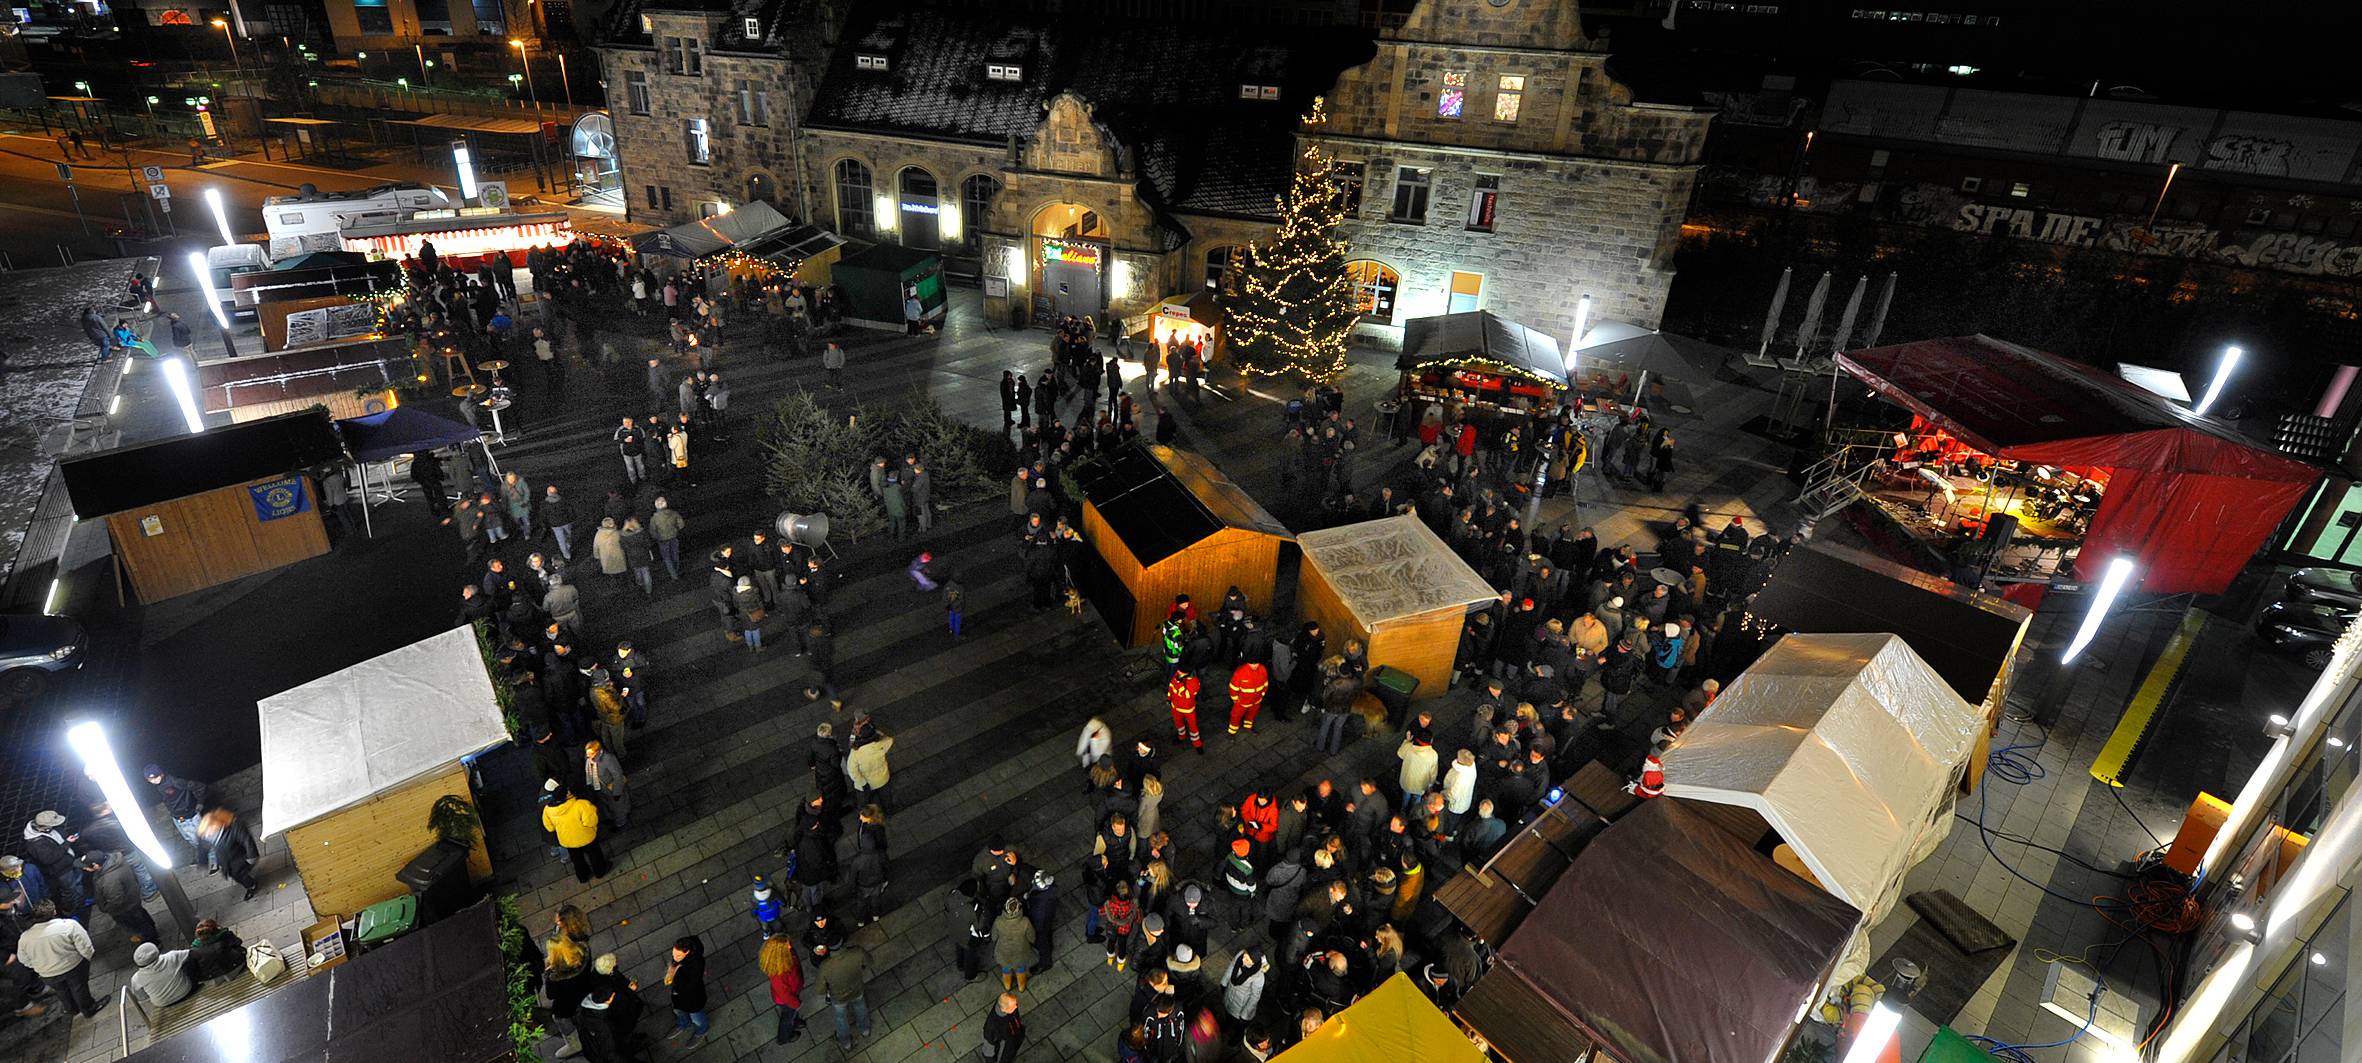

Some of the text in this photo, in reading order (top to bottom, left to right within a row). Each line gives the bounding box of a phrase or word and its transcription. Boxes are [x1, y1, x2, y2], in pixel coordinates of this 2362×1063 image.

[1954, 203, 2102, 246] SPADE
[254, 479, 296, 493] WELCOME
[272, 506, 296, 516] LIONS
